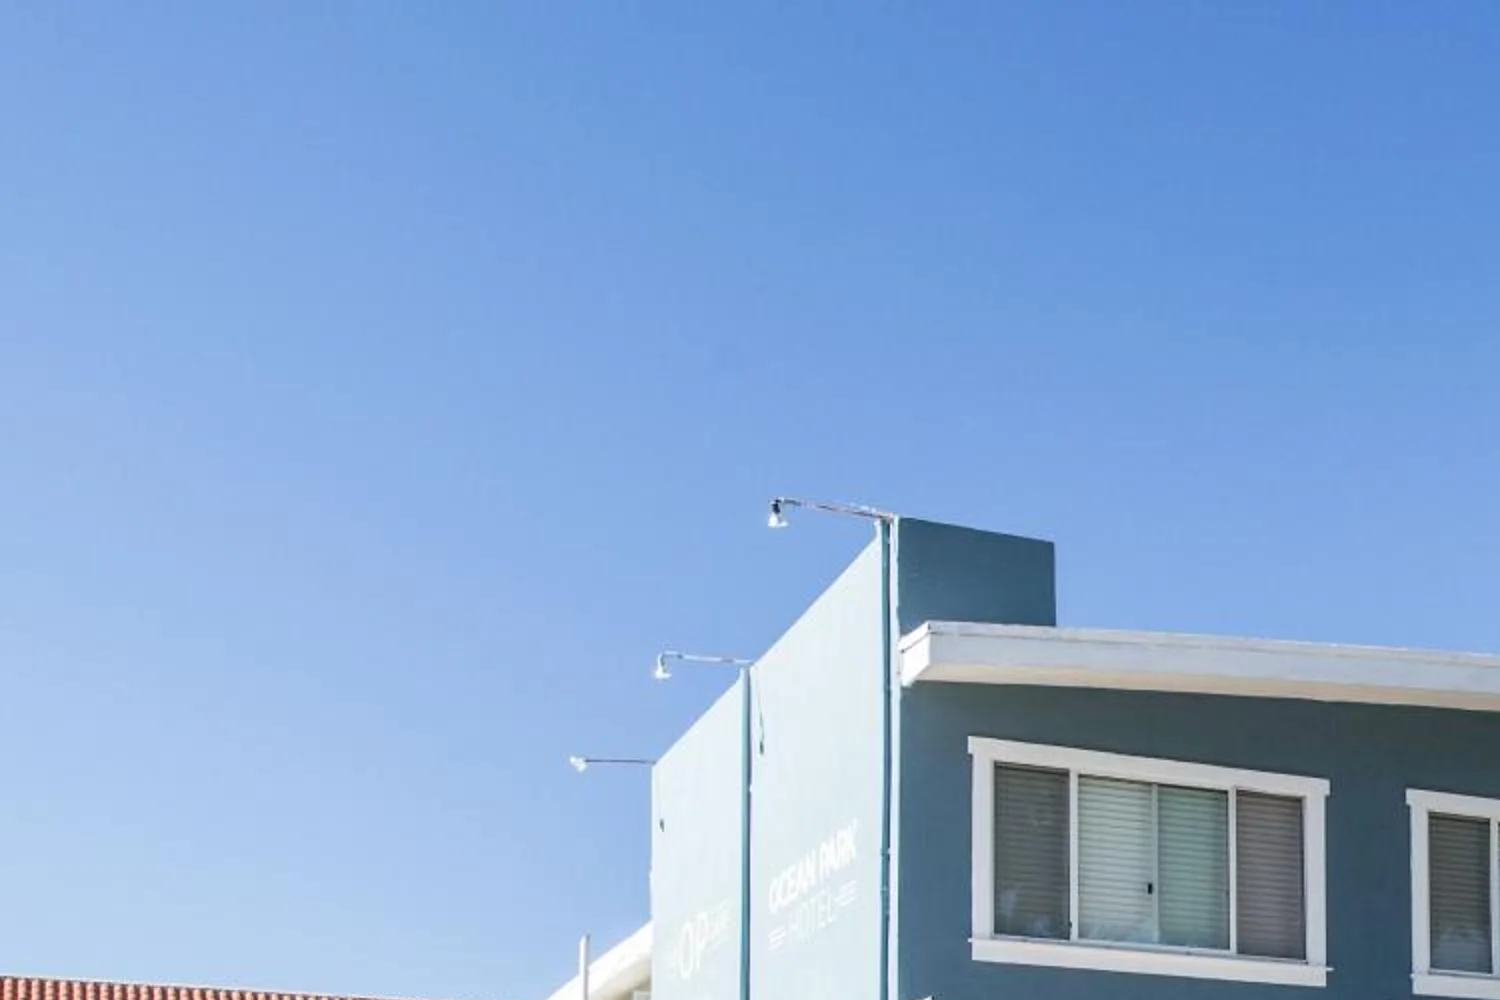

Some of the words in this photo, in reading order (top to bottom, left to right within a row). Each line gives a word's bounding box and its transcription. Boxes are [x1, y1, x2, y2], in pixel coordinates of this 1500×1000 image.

[769, 848, 817, 914] OCEAN
[818, 818, 857, 886] PARK
[788, 889, 837, 945] HOTEL
